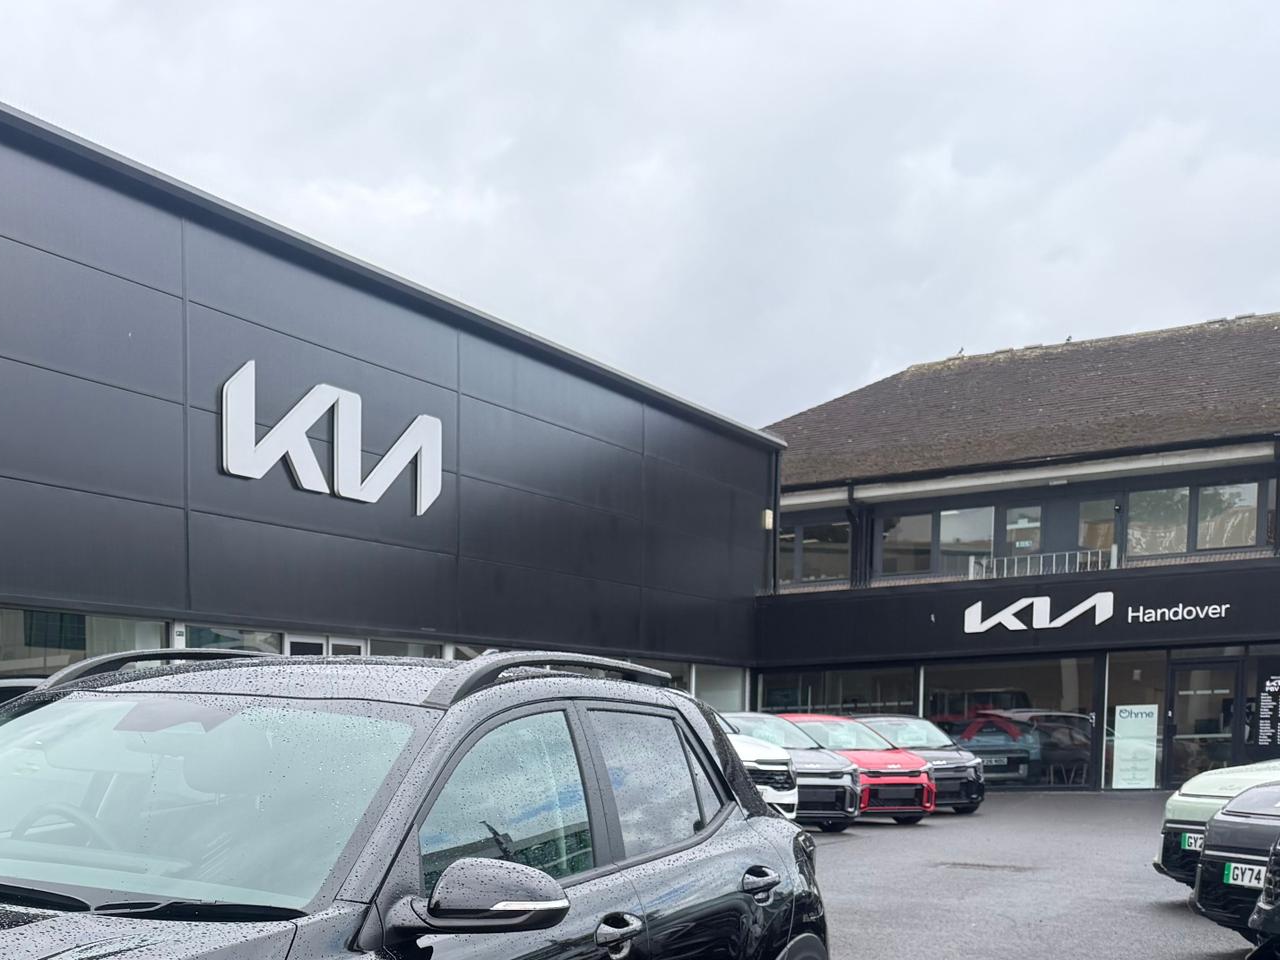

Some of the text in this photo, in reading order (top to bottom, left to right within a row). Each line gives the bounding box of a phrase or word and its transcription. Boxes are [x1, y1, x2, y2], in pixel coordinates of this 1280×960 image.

[222, 360, 442, 516] KIA
[964, 592, 1230, 634] KIA Handover
